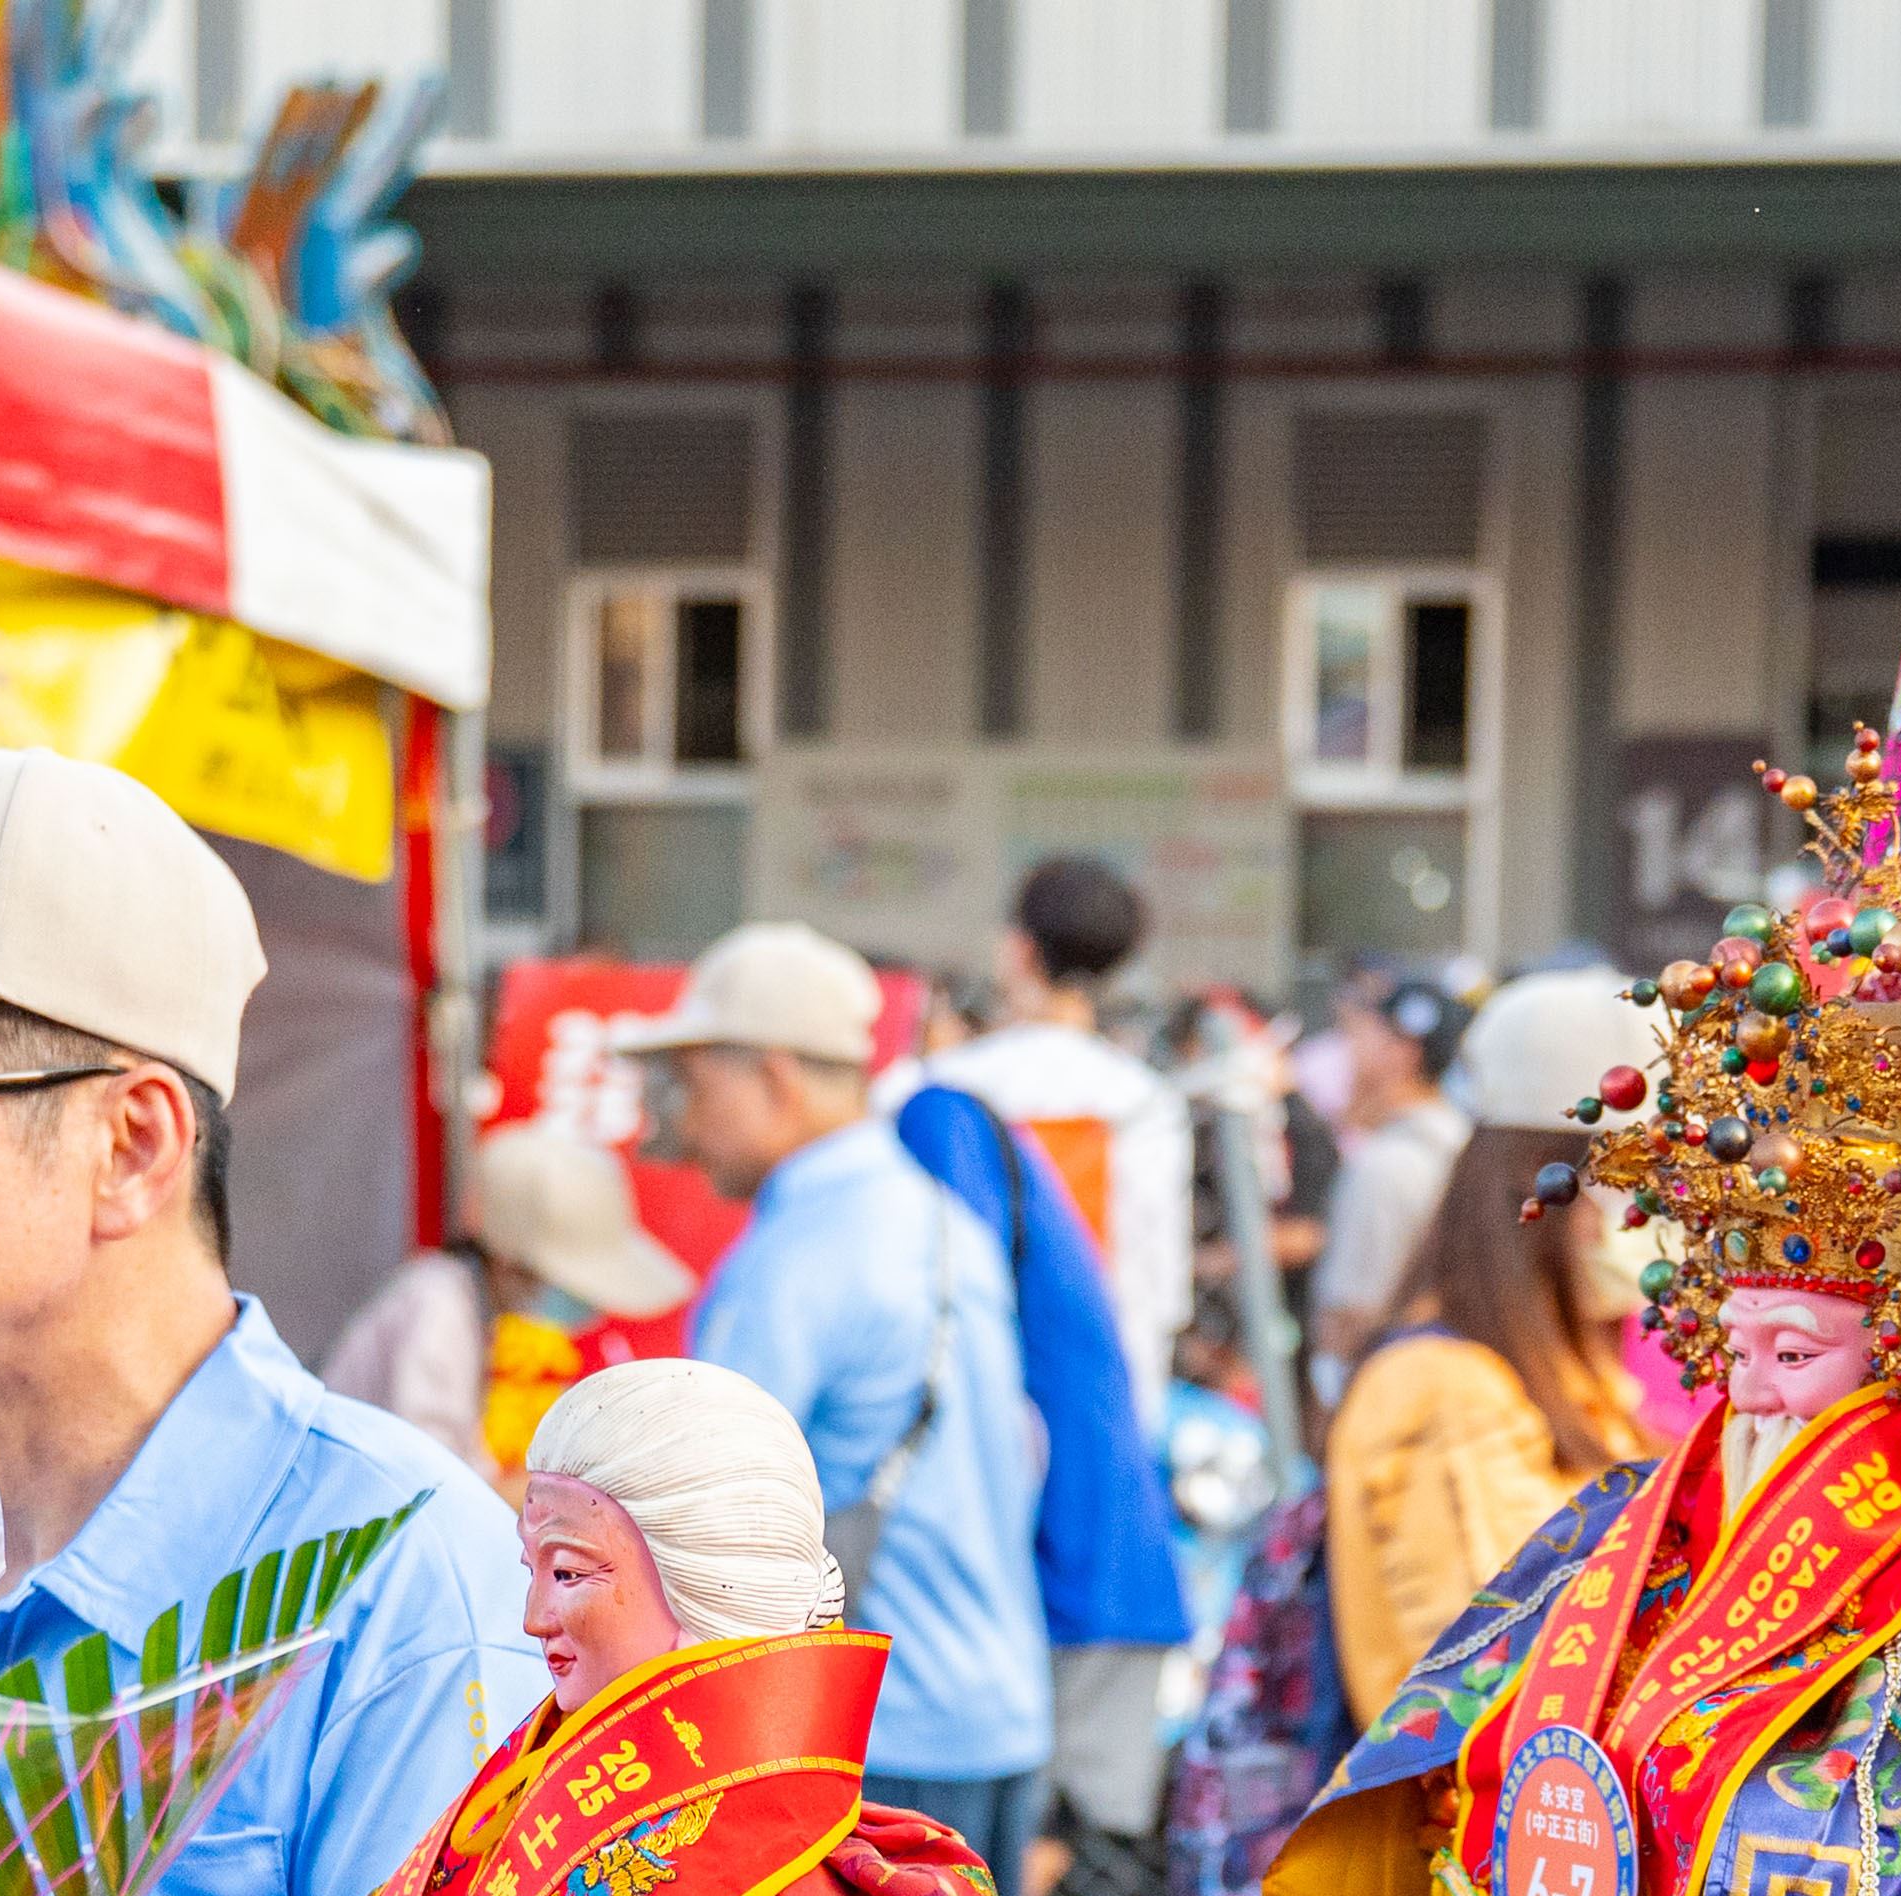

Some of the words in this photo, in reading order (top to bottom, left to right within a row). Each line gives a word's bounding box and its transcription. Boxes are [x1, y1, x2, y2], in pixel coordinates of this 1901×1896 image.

[1822, 1472, 1884, 1529] 25
[1726, 1516, 1814, 1629] GOOD
[1669, 1542, 1841, 1697] TAOYUAN
[566, 1764, 616, 1818] 25
[599, 1740, 651, 1793] 20
[1539, 1781, 1586, 1814] 永安宮
[1525, 1808, 1600, 1850] (中正五街)
